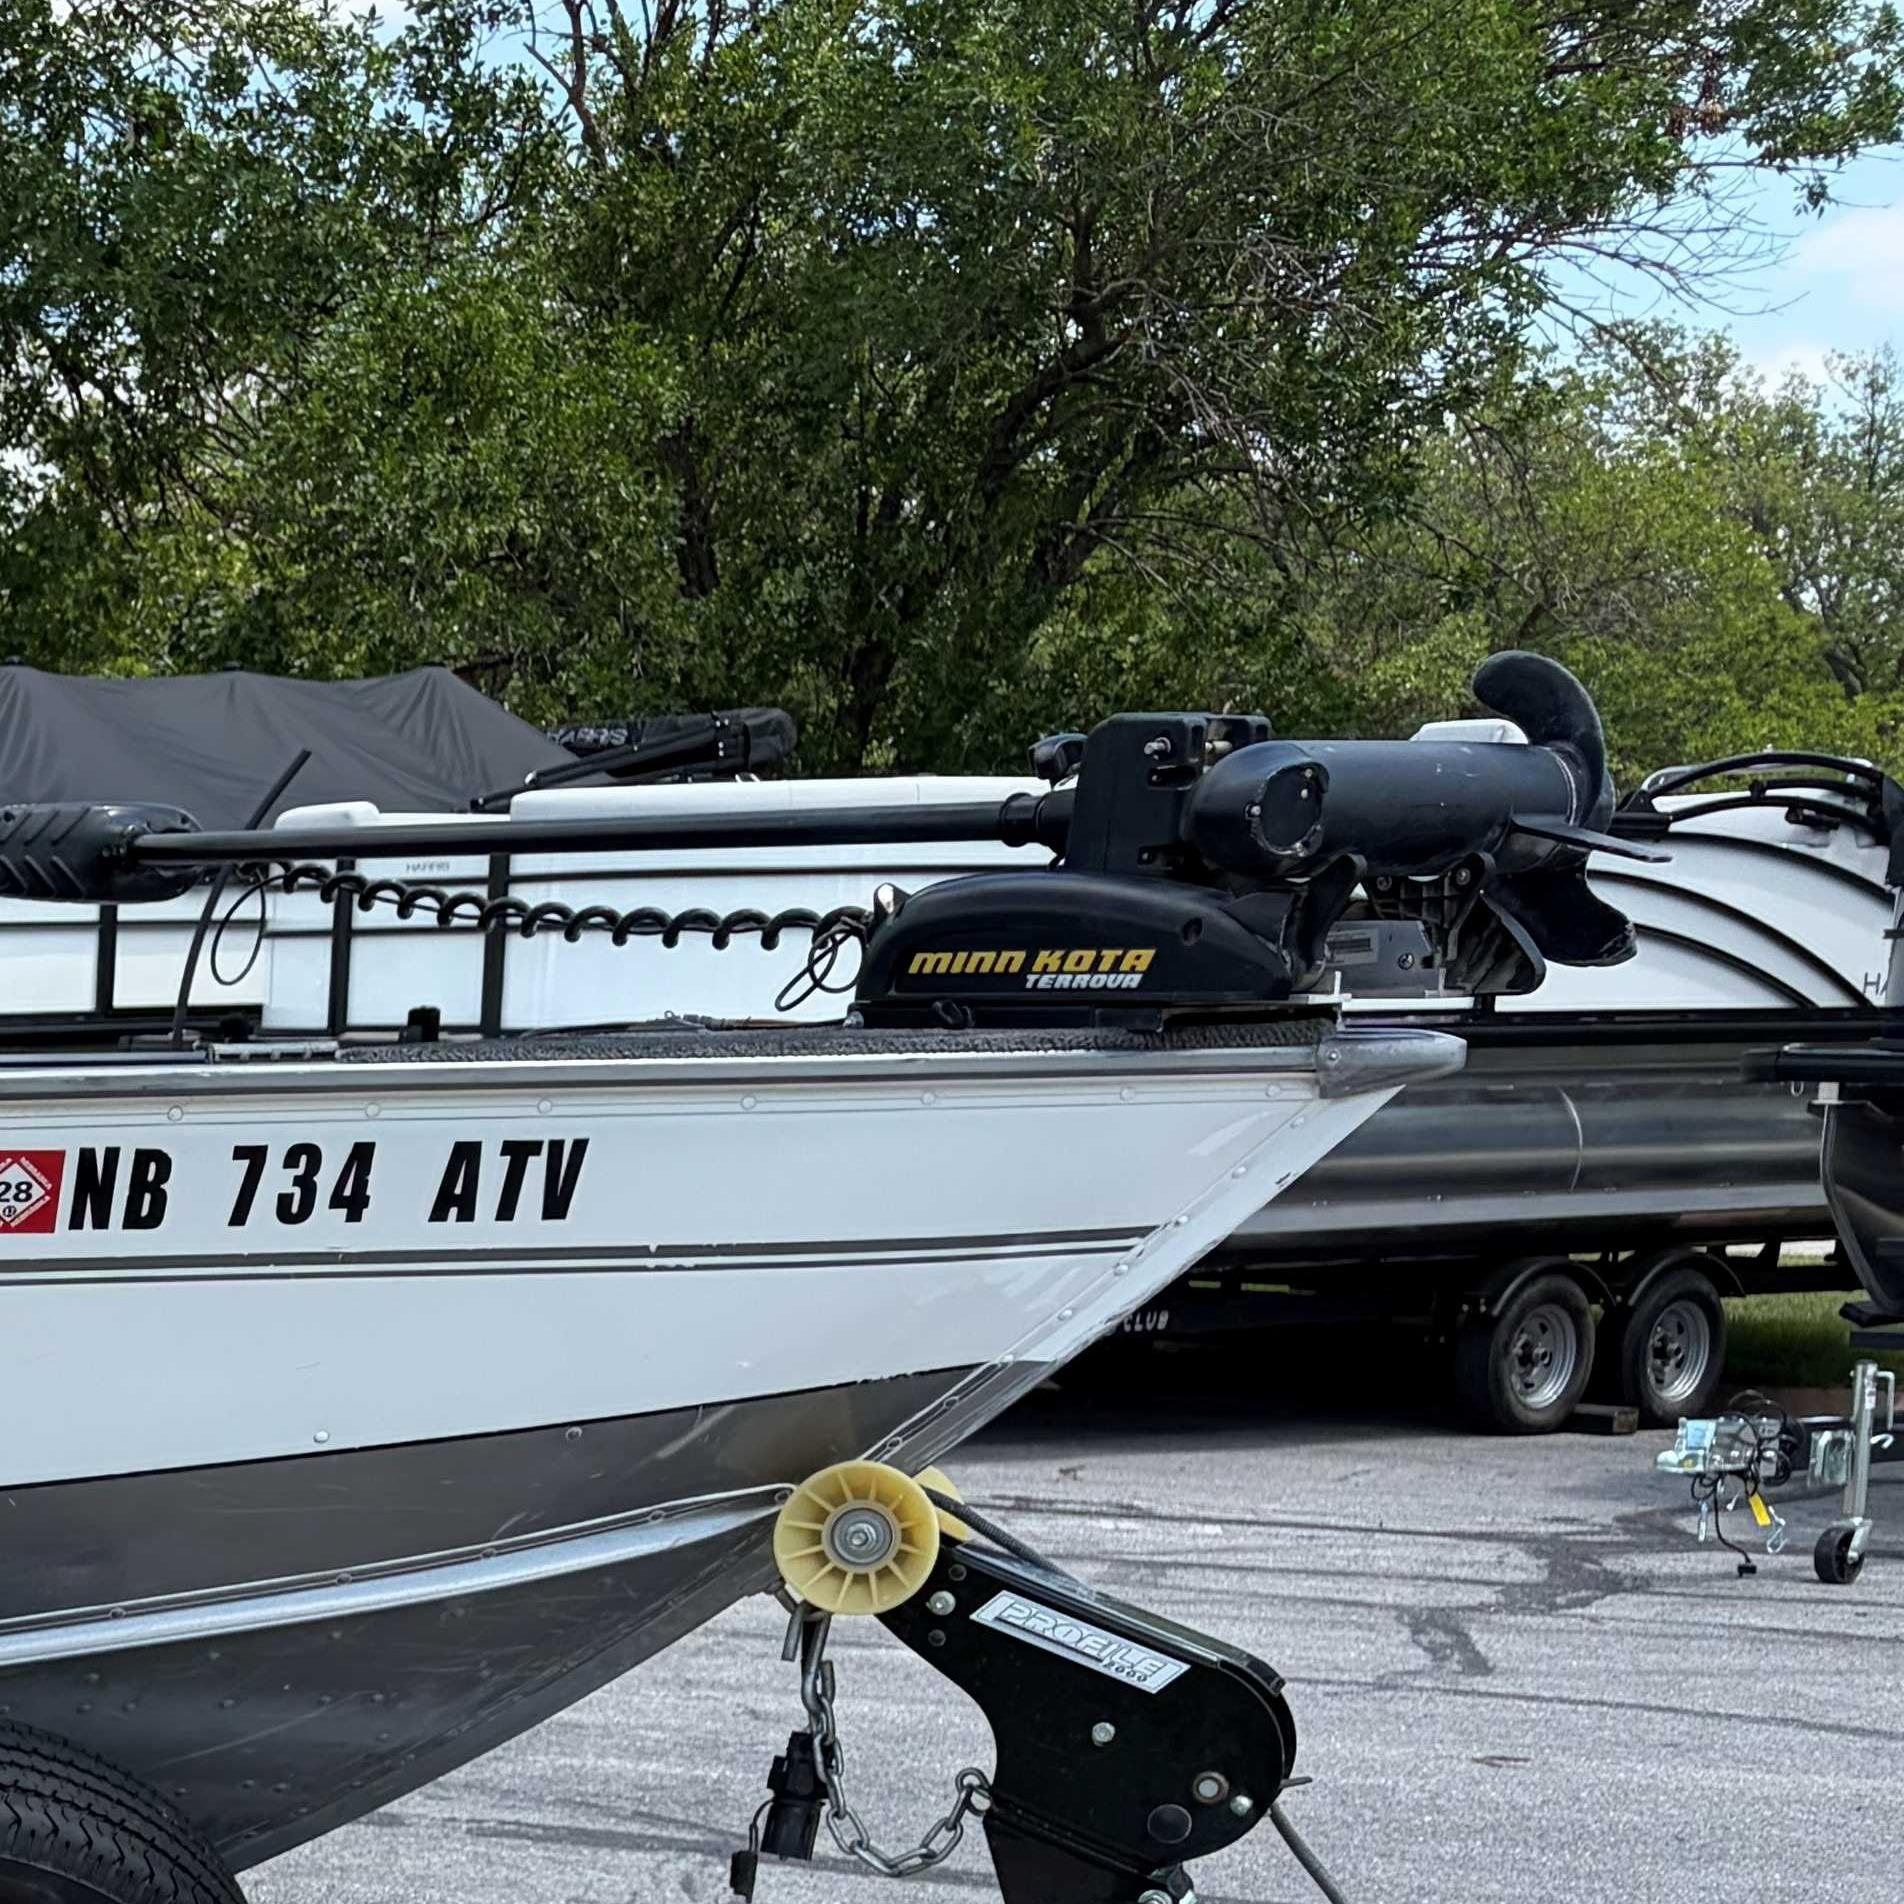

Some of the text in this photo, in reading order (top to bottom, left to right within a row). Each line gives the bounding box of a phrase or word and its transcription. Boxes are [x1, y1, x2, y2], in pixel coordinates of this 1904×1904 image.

[1031, 949, 1156, 973] KOTA
[1025, 973, 1143, 989] TERROVA
[68, 1138, 590, 1231] NB 734 ATV
[995, 1601, 1166, 1677] PROFILE
[1102, 1661, 1148, 1683] 2000
